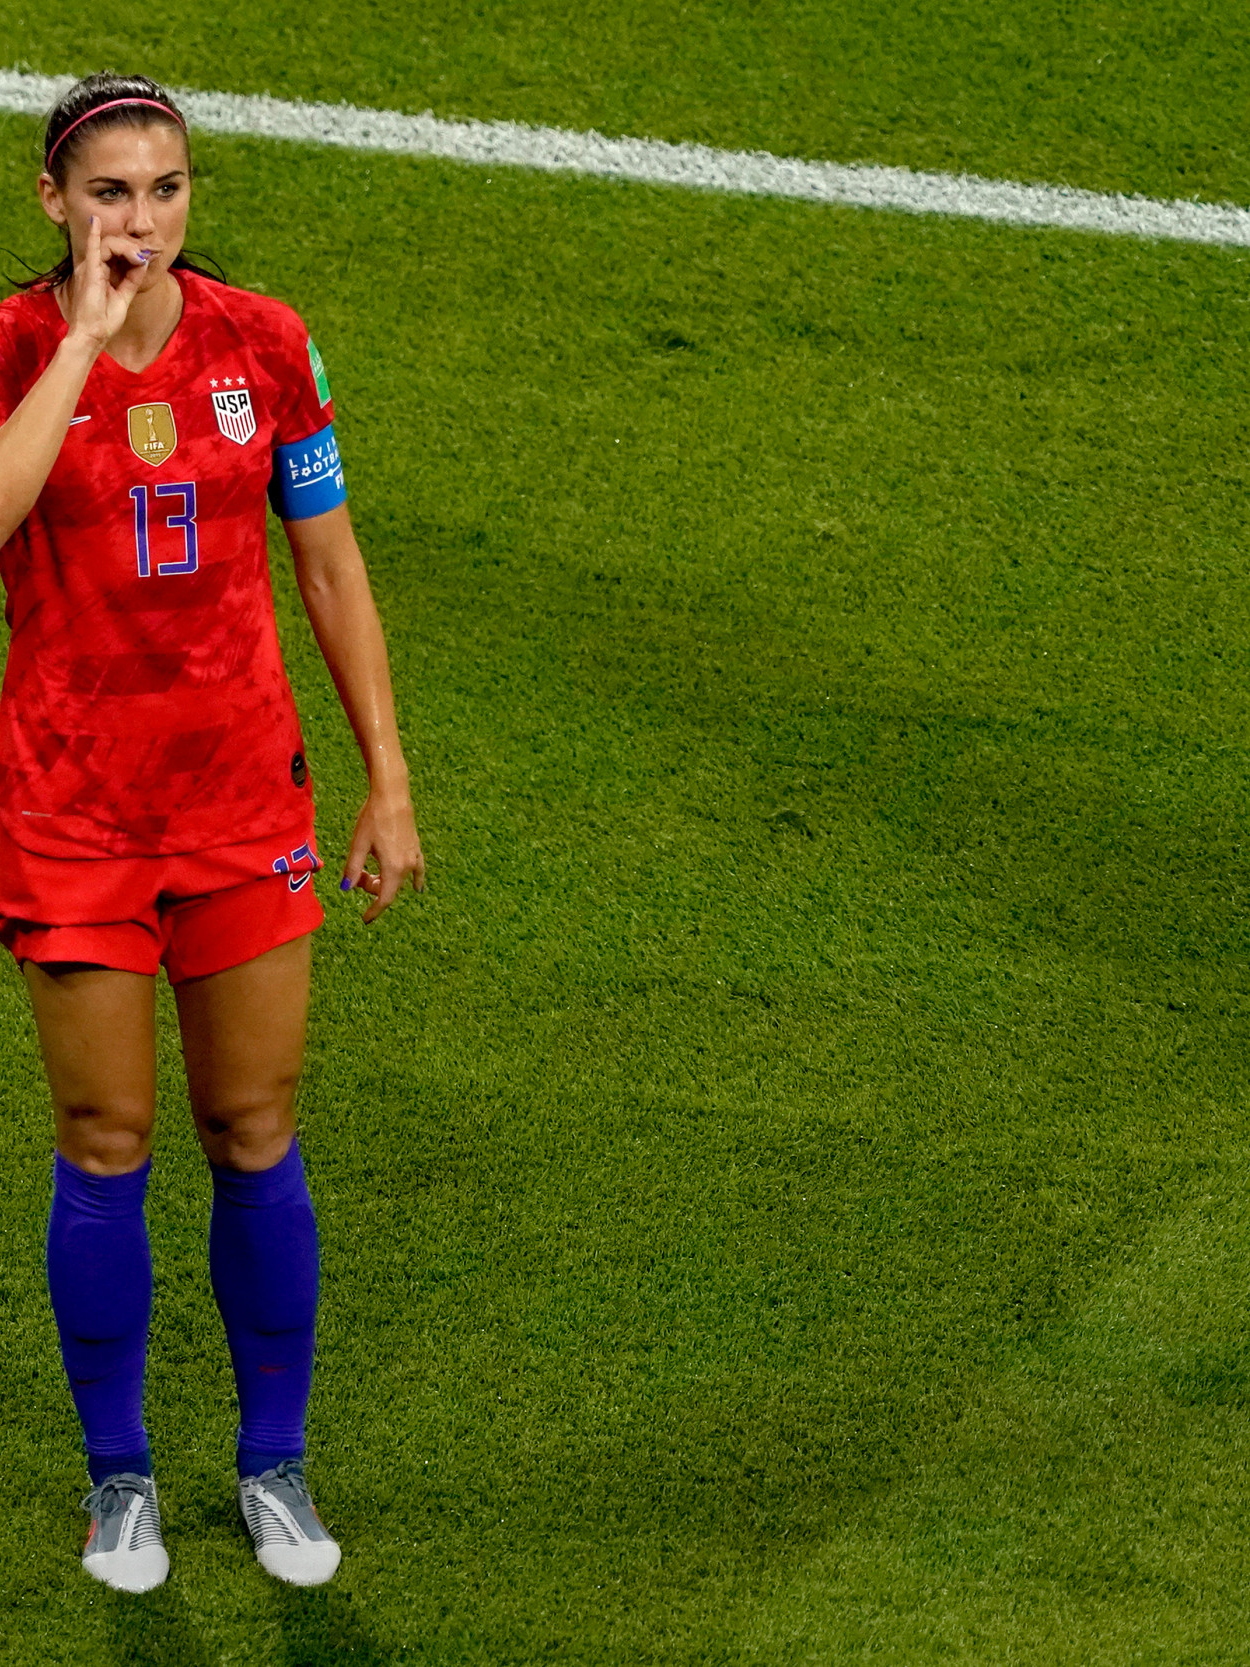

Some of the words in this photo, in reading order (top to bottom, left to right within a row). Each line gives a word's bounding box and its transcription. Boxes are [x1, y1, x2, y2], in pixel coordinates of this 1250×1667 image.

[215, 393, 248, 414] USA
[144, 441, 165, 451] FIFA
[129, 481, 199, 577] 13
